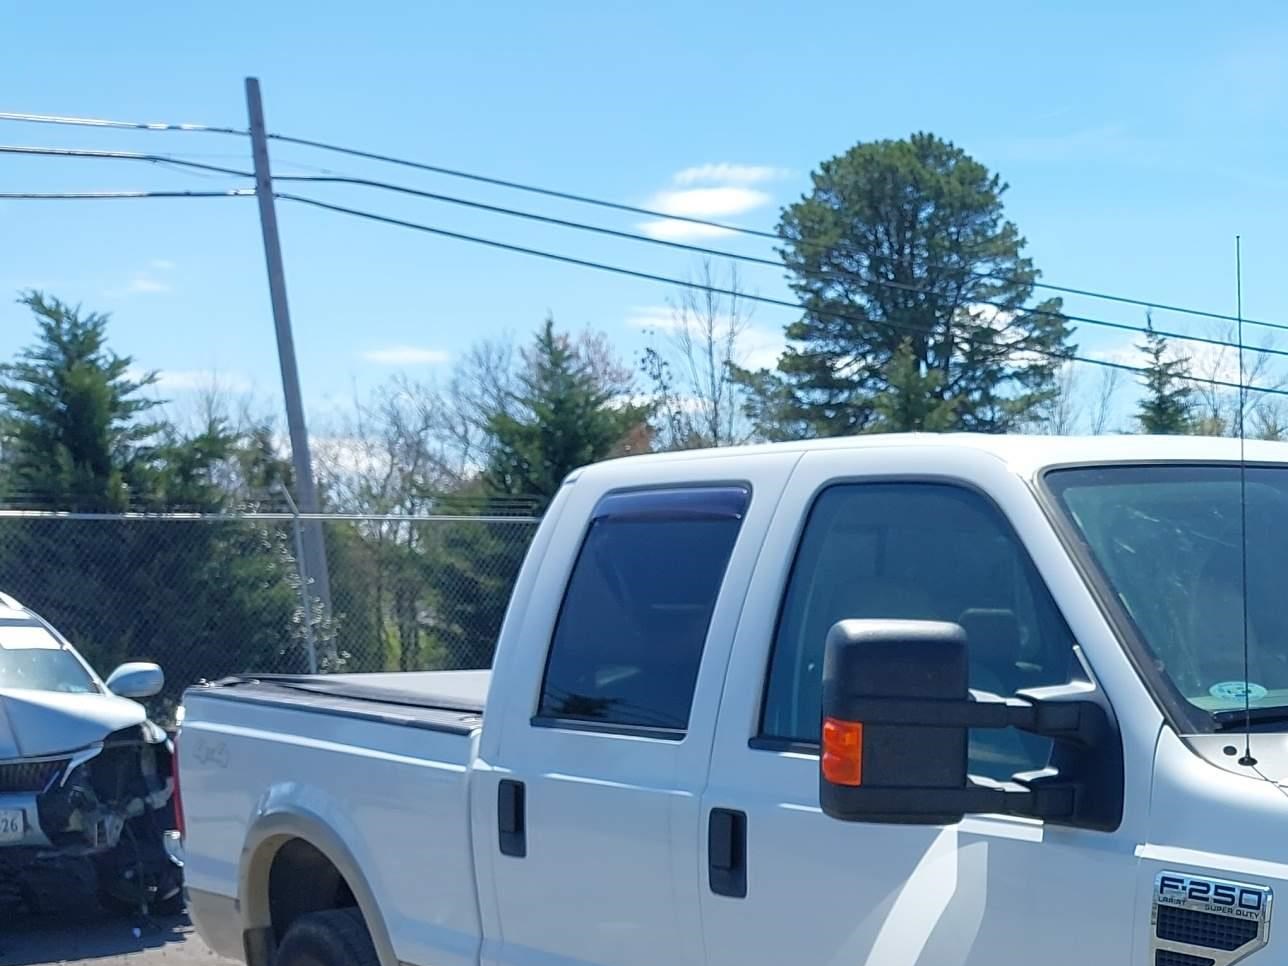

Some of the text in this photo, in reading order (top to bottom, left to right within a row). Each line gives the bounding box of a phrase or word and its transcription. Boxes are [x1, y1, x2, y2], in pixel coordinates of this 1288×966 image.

[1159, 876, 1263, 911] F-250
[1204, 904, 1234, 915] SUPER
[1235, 909, 1260, 920] DUTY
